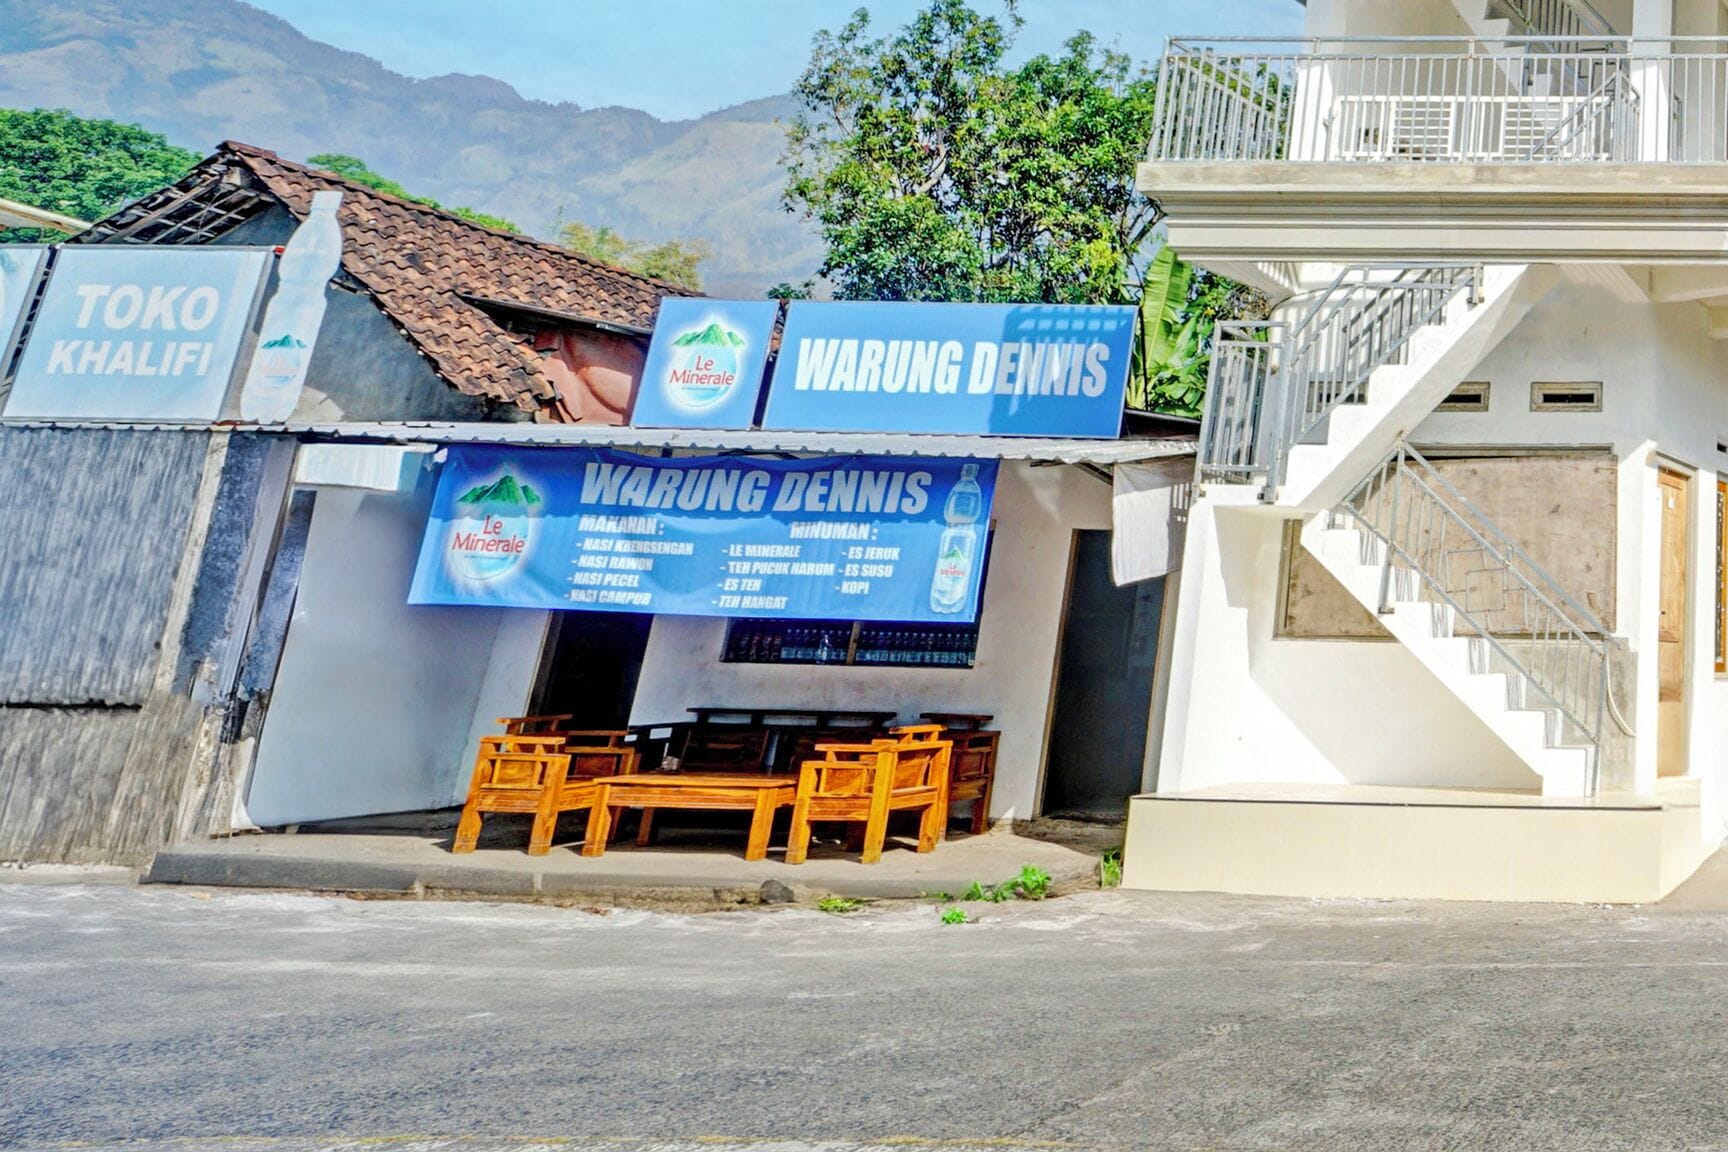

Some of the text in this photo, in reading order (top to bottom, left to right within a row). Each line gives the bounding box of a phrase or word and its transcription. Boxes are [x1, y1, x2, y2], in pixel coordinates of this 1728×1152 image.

[76, 284, 220, 331] TOKO
[46, 339, 214, 377] KHALIFI
[695, 355, 714, 371] Le
[794, 338, 1110, 397] WARUNG DENNIS
[669, 369, 735, 386] Minerale
[579, 462, 933, 515] WARUNG DENNIS
[483, 515, 503, 535] Le
[579, 514, 657, 535] MAKANAN
[790, 521, 871, 540] MINUMAN
[452, 532, 525, 553] Minerale
[582, 538, 612, 552] NASI
[729, 544, 801, 558] LE MINERALE
[848, 546, 901, 561] ES JERUK
[577, 554, 654, 571] NASI RAWON
[727, 561, 835, 576] TEH PUCUK HARUM
[844, 563, 894, 578] ES SUSU
[573, 571, 640, 587] NASI PECEL
[723, 578, 762, 592] ES TEH
[841, 581, 870, 595] KOPI
[570, 589, 652, 606] NASI CAMPUR
[718, 595, 789, 610] TEH HANGAT
